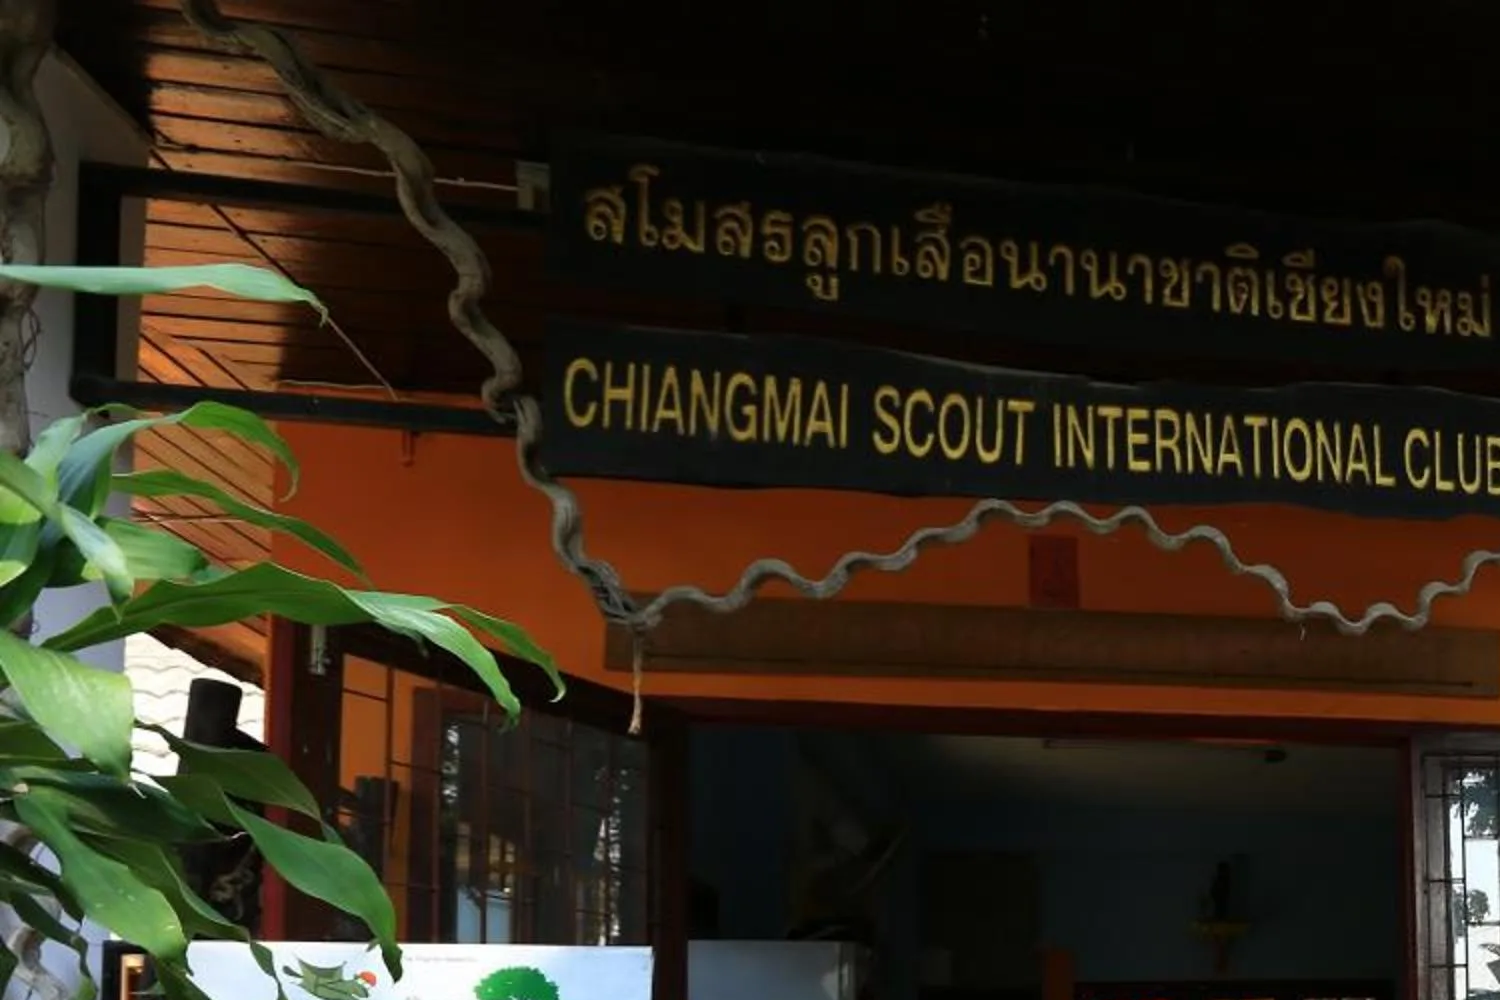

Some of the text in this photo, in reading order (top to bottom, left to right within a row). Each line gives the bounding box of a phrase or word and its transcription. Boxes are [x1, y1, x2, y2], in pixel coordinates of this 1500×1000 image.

[585, 164, 1491, 337] สโมสรลูกเสือนานาชาติเชียงใหม่
[564, 357, 849, 449] CHIANGMAI
[872, 385, 1034, 466] SCOUT
[1053, 404, 1396, 488] INTERNATIONAL
